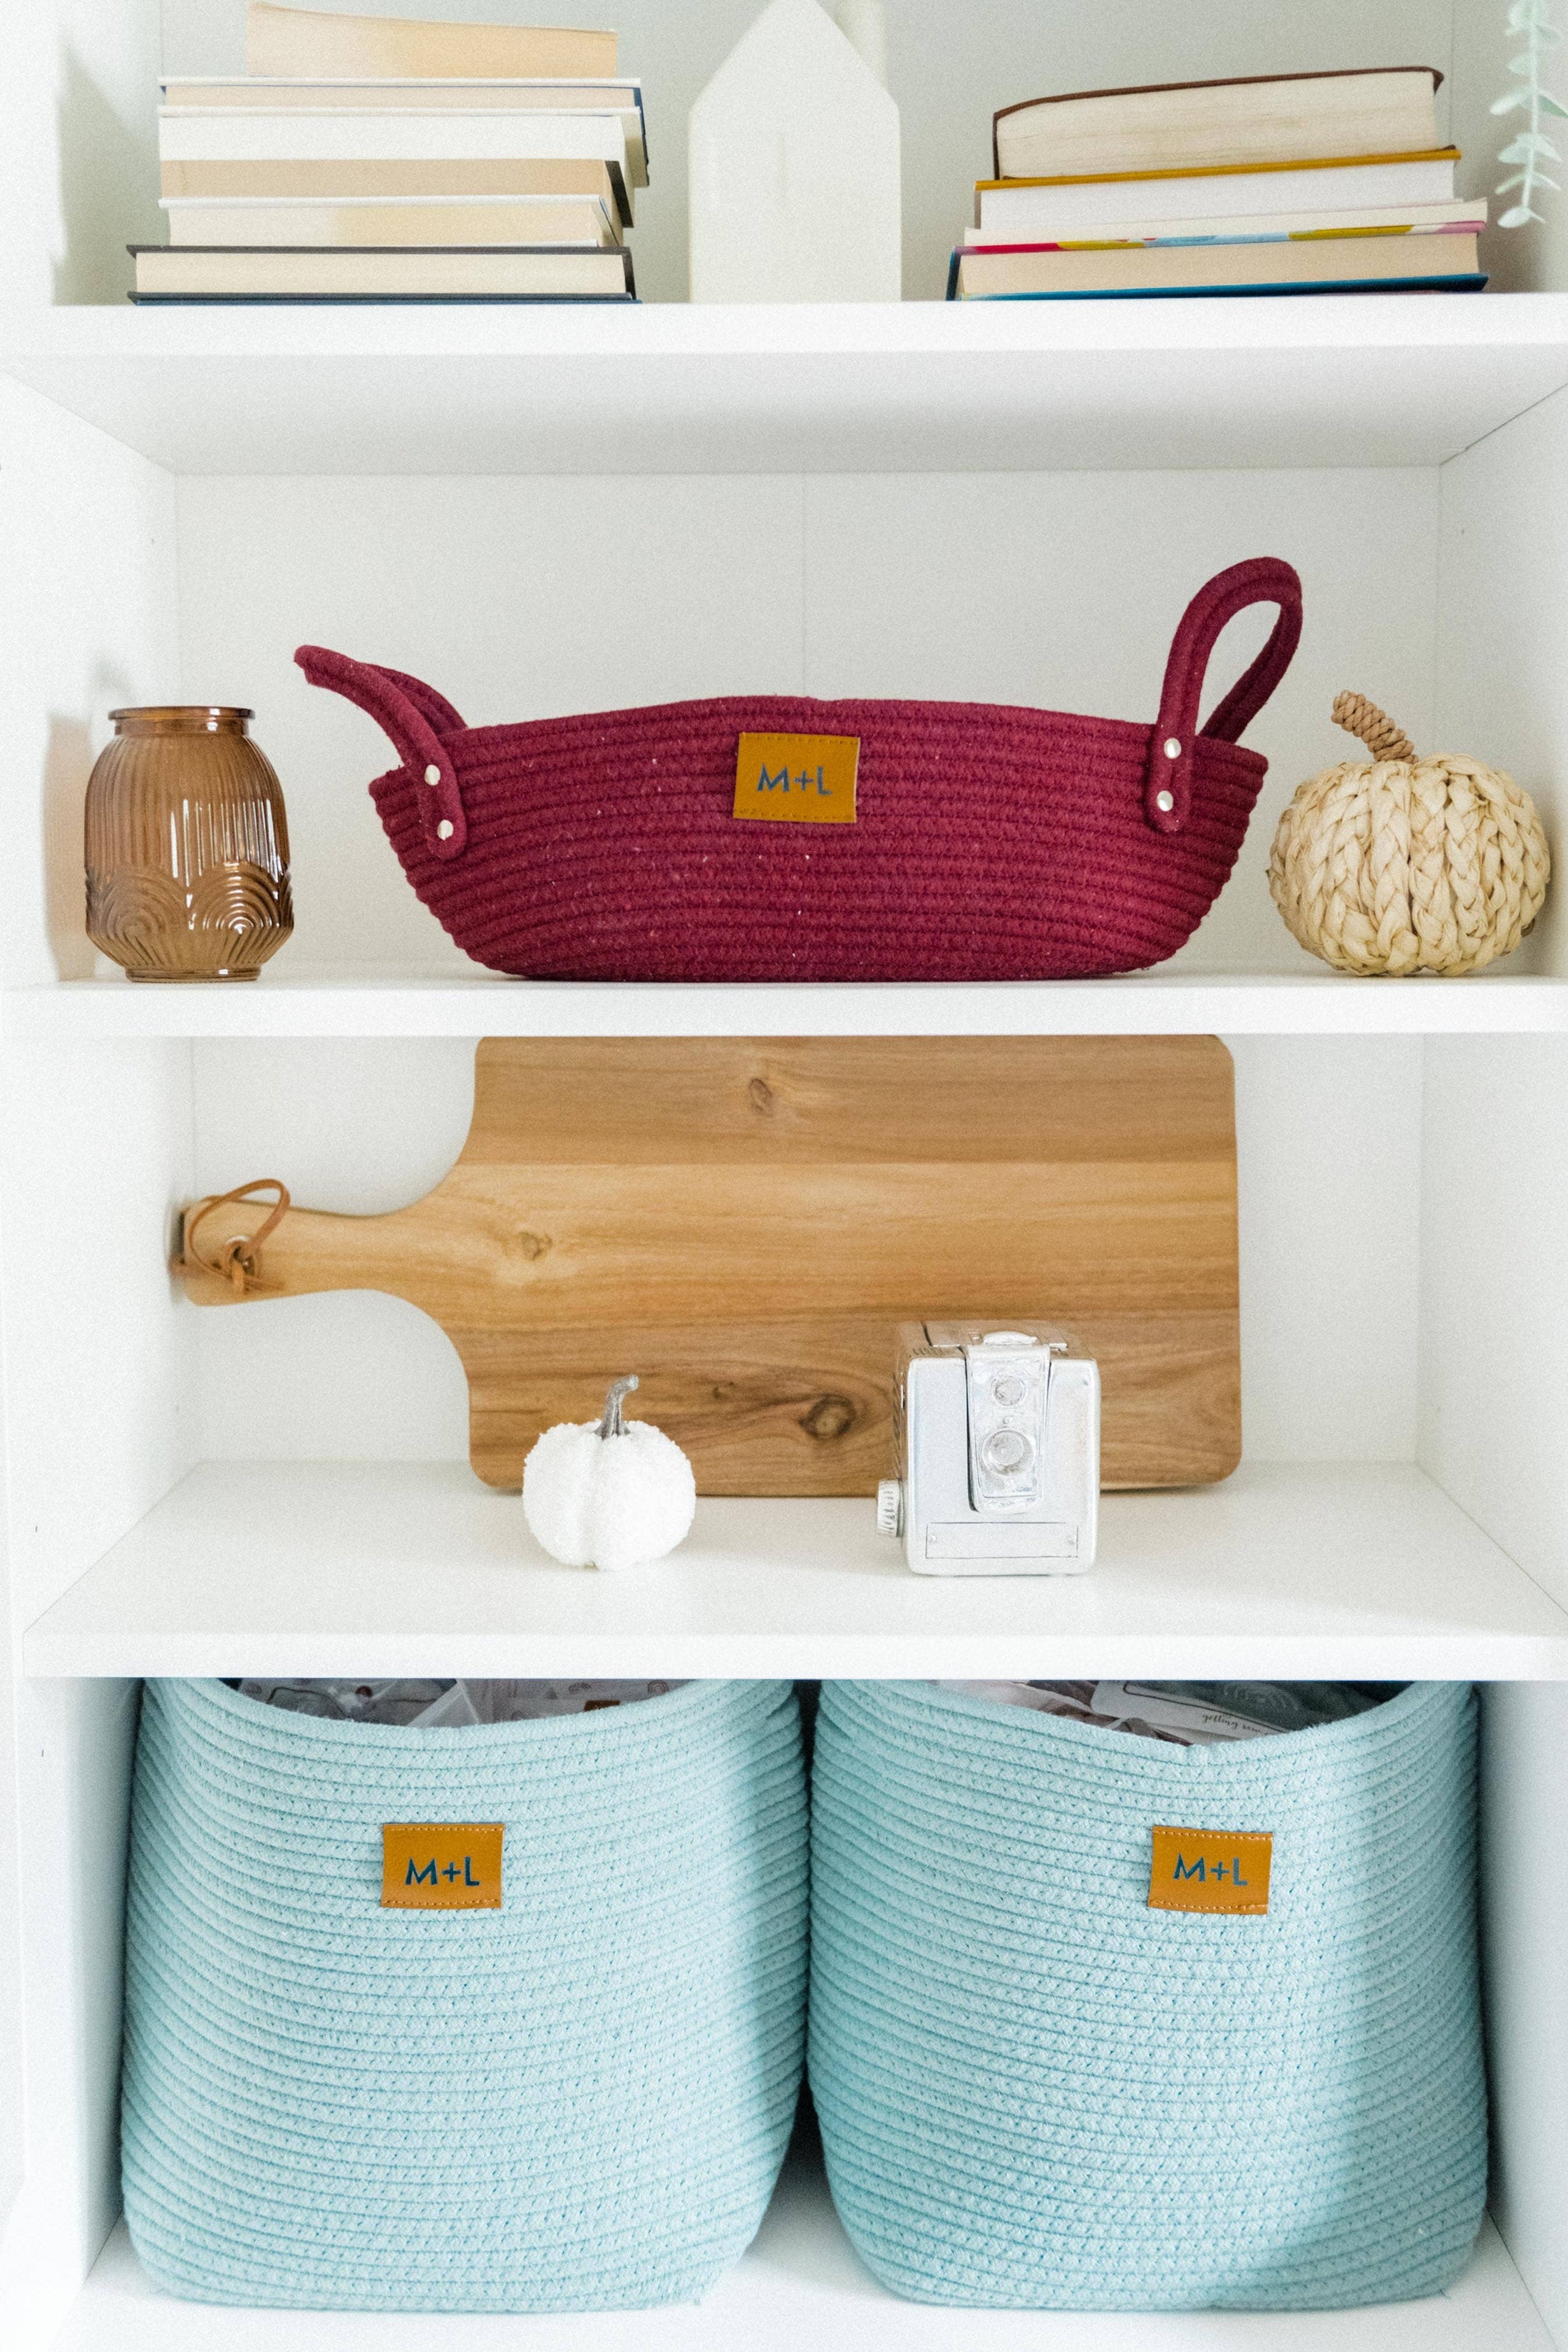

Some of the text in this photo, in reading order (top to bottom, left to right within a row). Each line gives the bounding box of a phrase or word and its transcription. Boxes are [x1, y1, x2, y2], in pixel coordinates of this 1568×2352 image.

[757, 762, 832, 795] M+L
[405, 1856, 480, 1886] M+L
[1173, 1852, 1248, 1885] M+L
